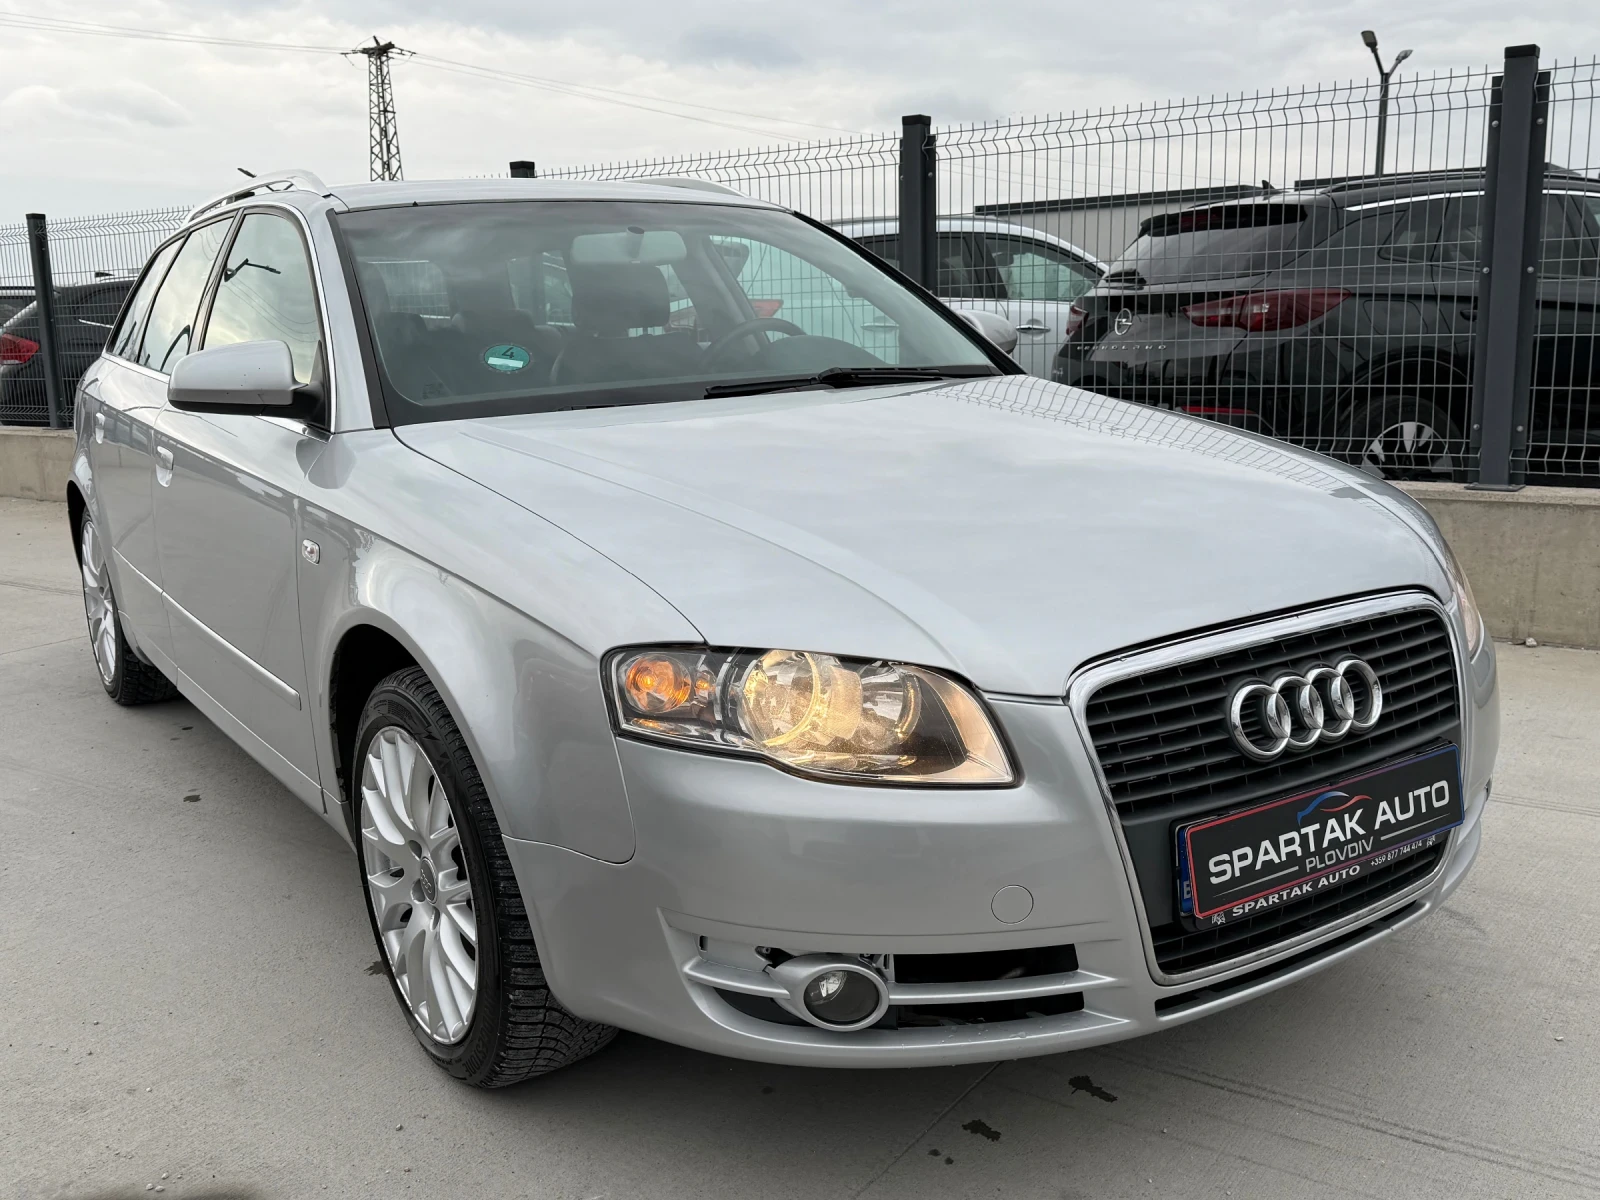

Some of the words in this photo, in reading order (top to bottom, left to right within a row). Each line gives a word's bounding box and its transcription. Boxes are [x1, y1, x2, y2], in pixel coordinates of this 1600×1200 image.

[501, 346, 515, 359] 4
[1208, 808, 1367, 884] SPARTAK
[1374, 780, 1450, 830] AUTO
[1305, 836, 1374, 873] PLOVDIV
[1232, 881, 1313, 917] SPARTAK
[1318, 865, 1361, 889] AUTO
[1370, 855, 1386, 866] +359
[1387, 849, 1399, 861] 877
